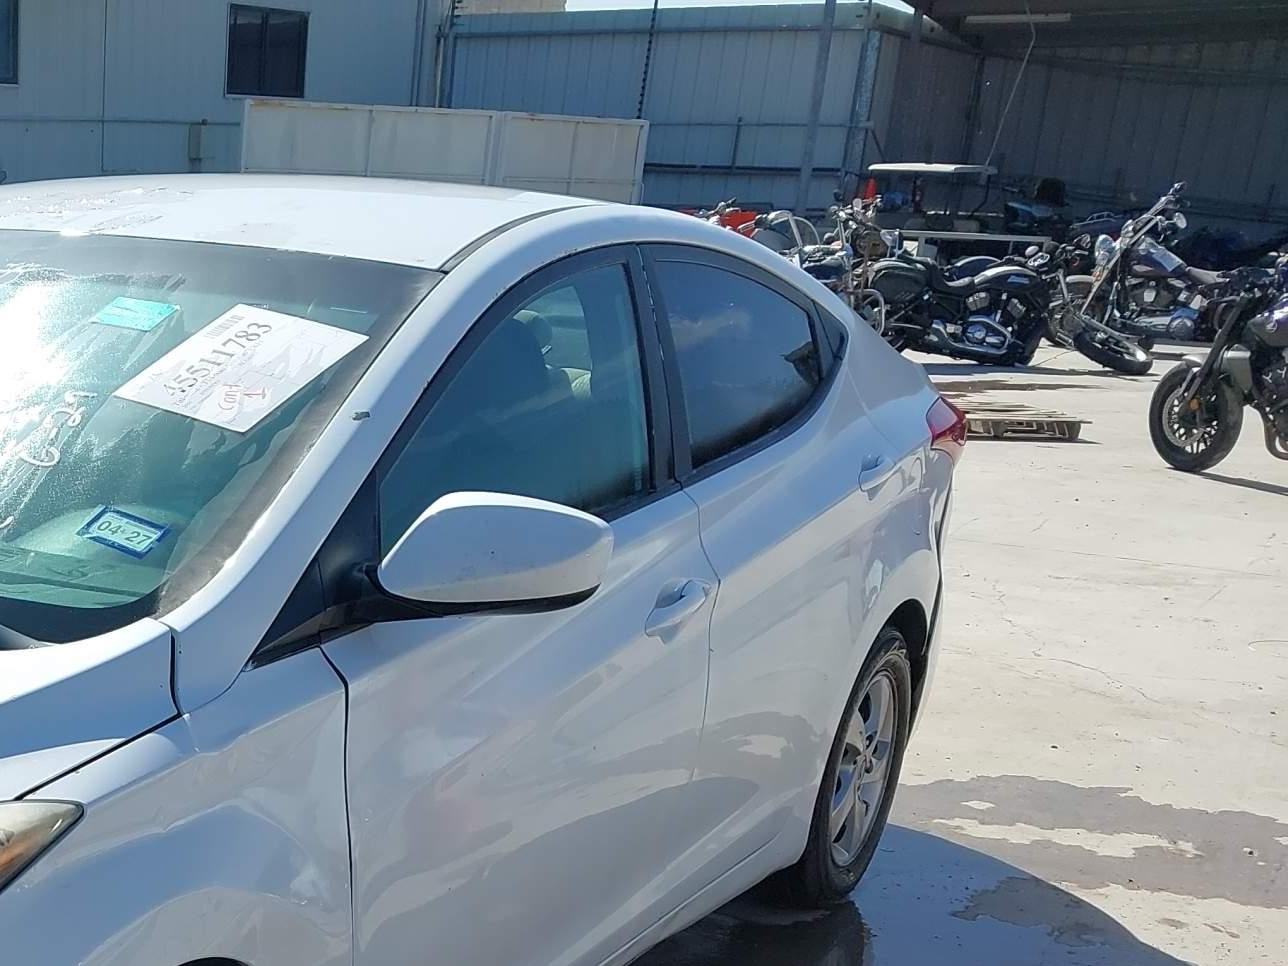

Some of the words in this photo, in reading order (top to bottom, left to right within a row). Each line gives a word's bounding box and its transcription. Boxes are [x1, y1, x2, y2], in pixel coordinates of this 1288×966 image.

[163, 322, 273, 396] 45511783
[96, 519, 123, 536] 04
[124, 530, 153, 546] 27
